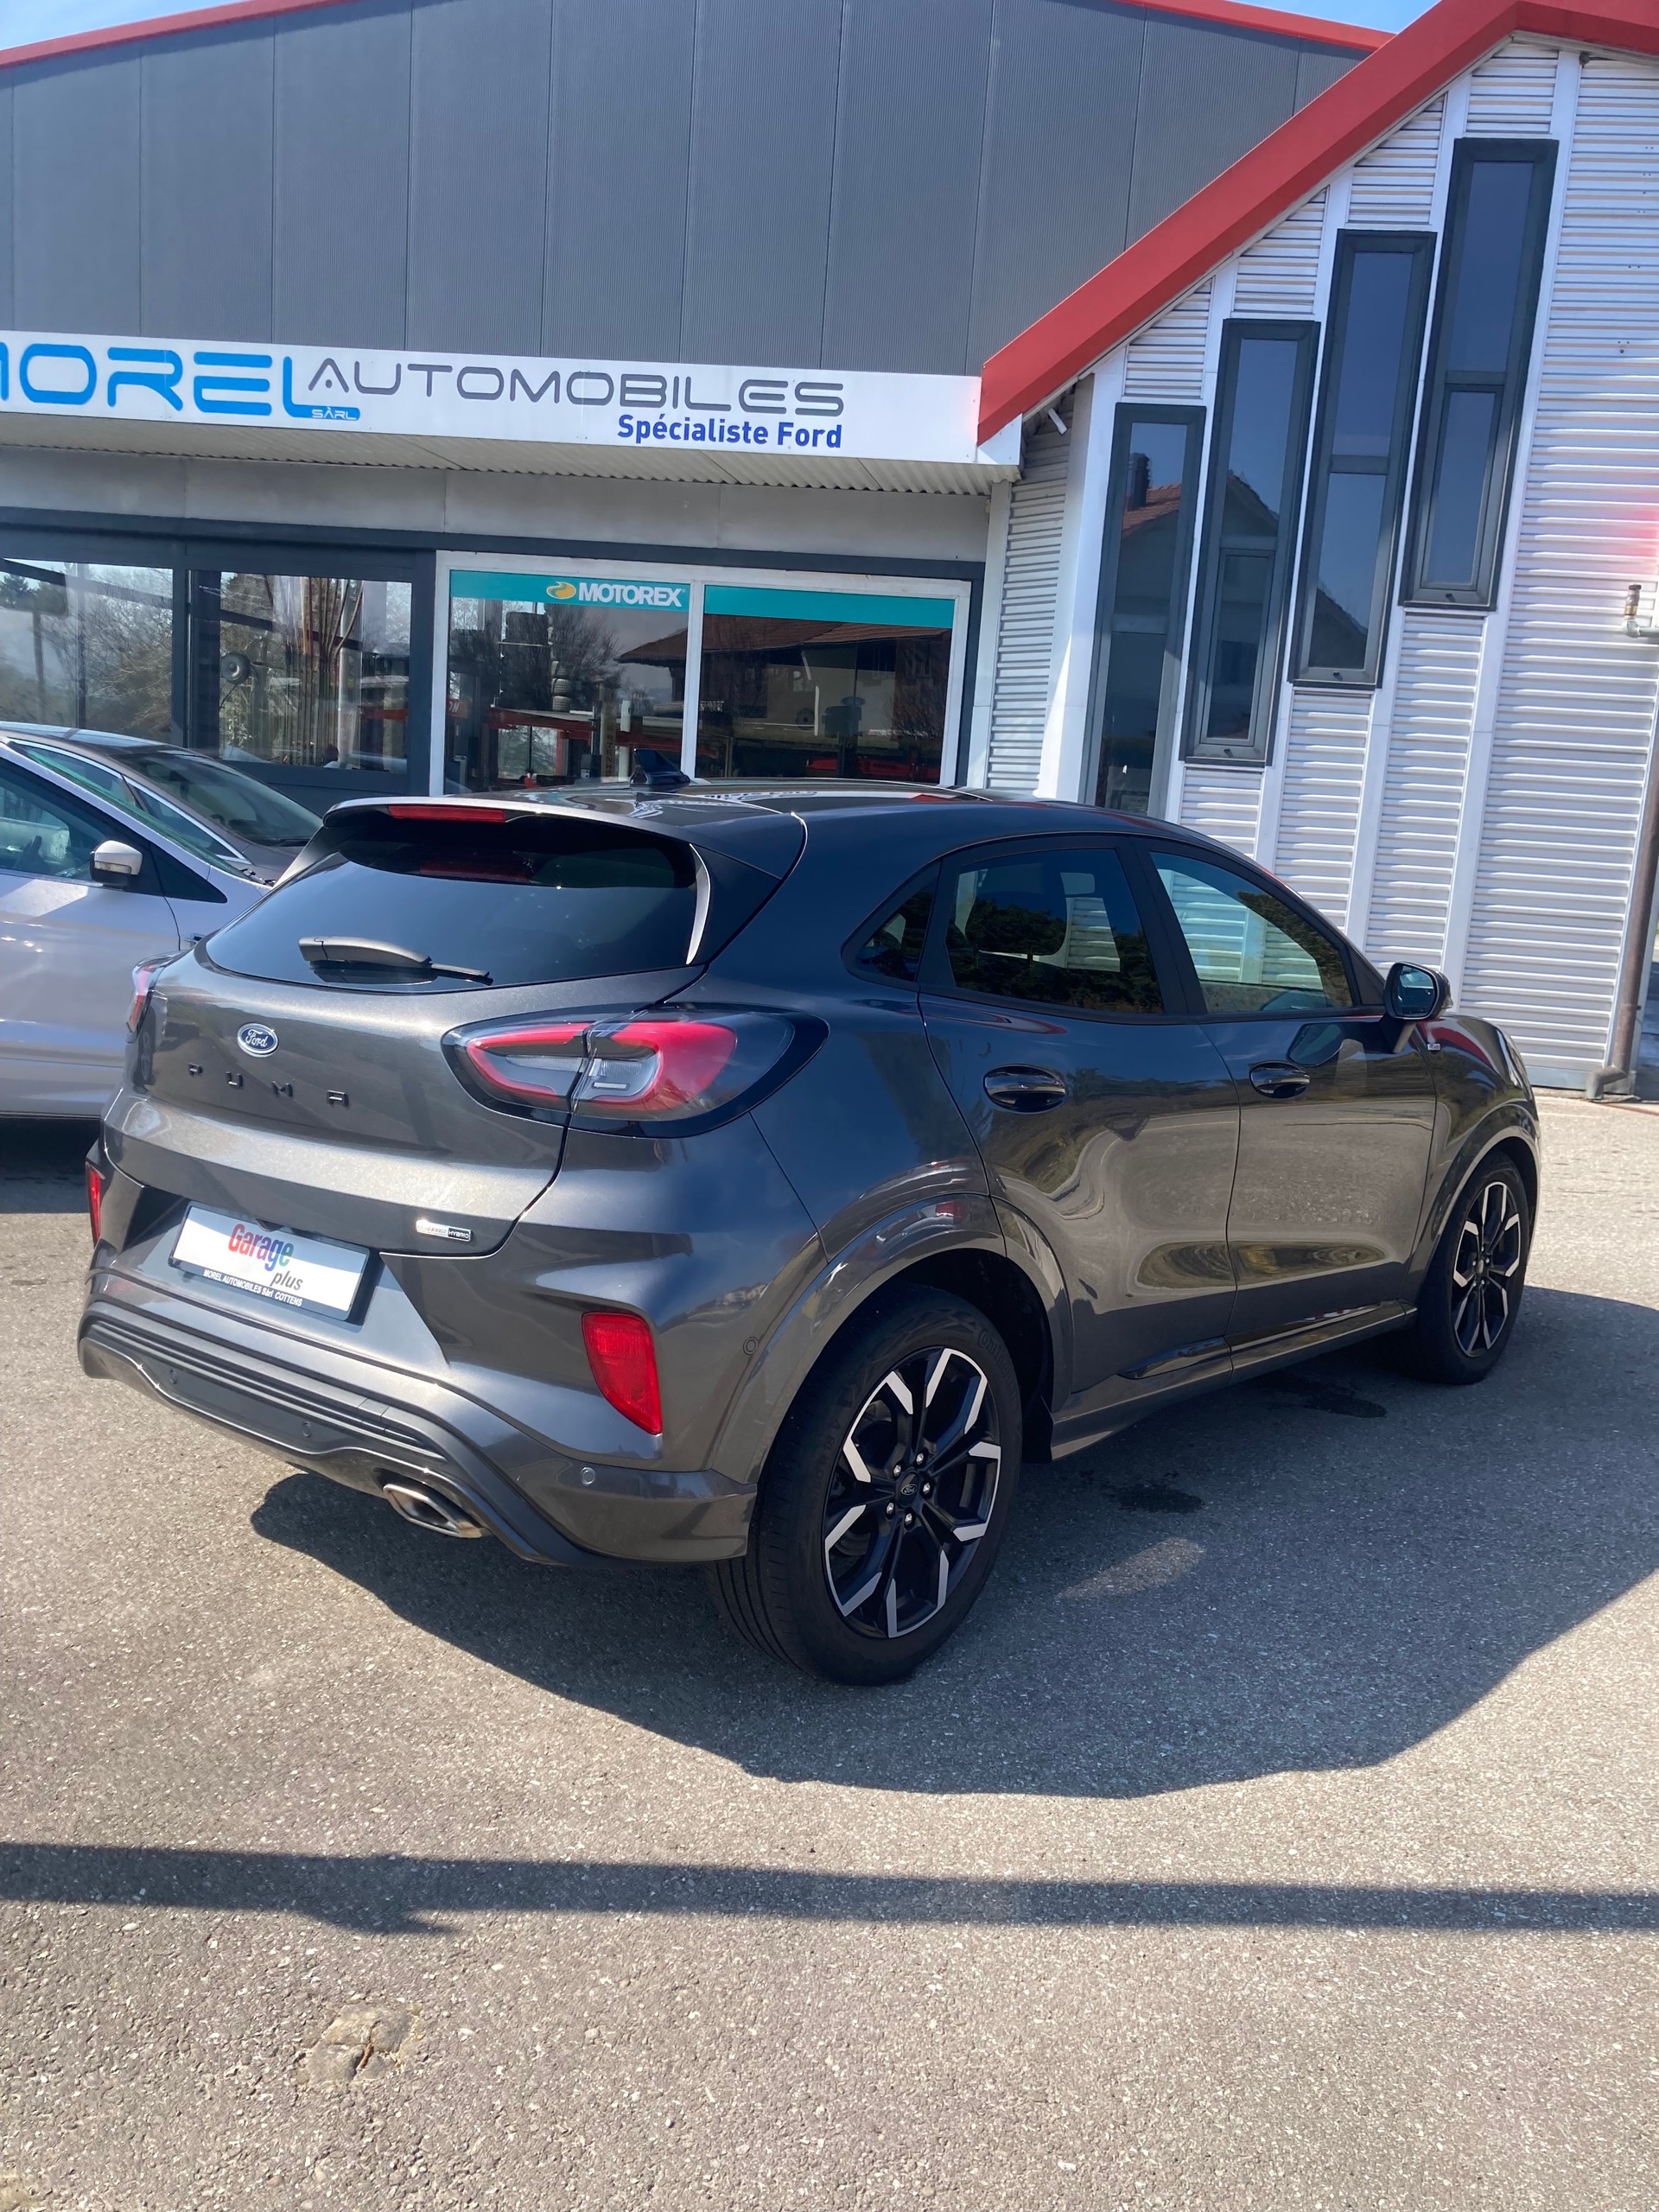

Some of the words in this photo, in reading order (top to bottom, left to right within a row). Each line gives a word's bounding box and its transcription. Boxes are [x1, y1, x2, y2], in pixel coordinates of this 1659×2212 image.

[0, 341, 360, 421] OREL
[308, 357, 844, 417] AUTOMOBILES
[617, 414, 769, 444] Spécialiste
[777, 422, 842, 448] Ford
[578, 582, 683, 607] MOTOREX
[245, 1028, 269, 1049] Ford
[188, 1062, 350, 1109] PUMA
[227, 1223, 295, 1272] Garage
[448, 1230, 469, 1239] HYBRID
[202, 1268, 222, 1282] MOREL
[221, 1274, 263, 1294] AUTOMOBILES
[275, 1291, 303, 1307] COTTENS
[270, 1270, 303, 1291] plus
